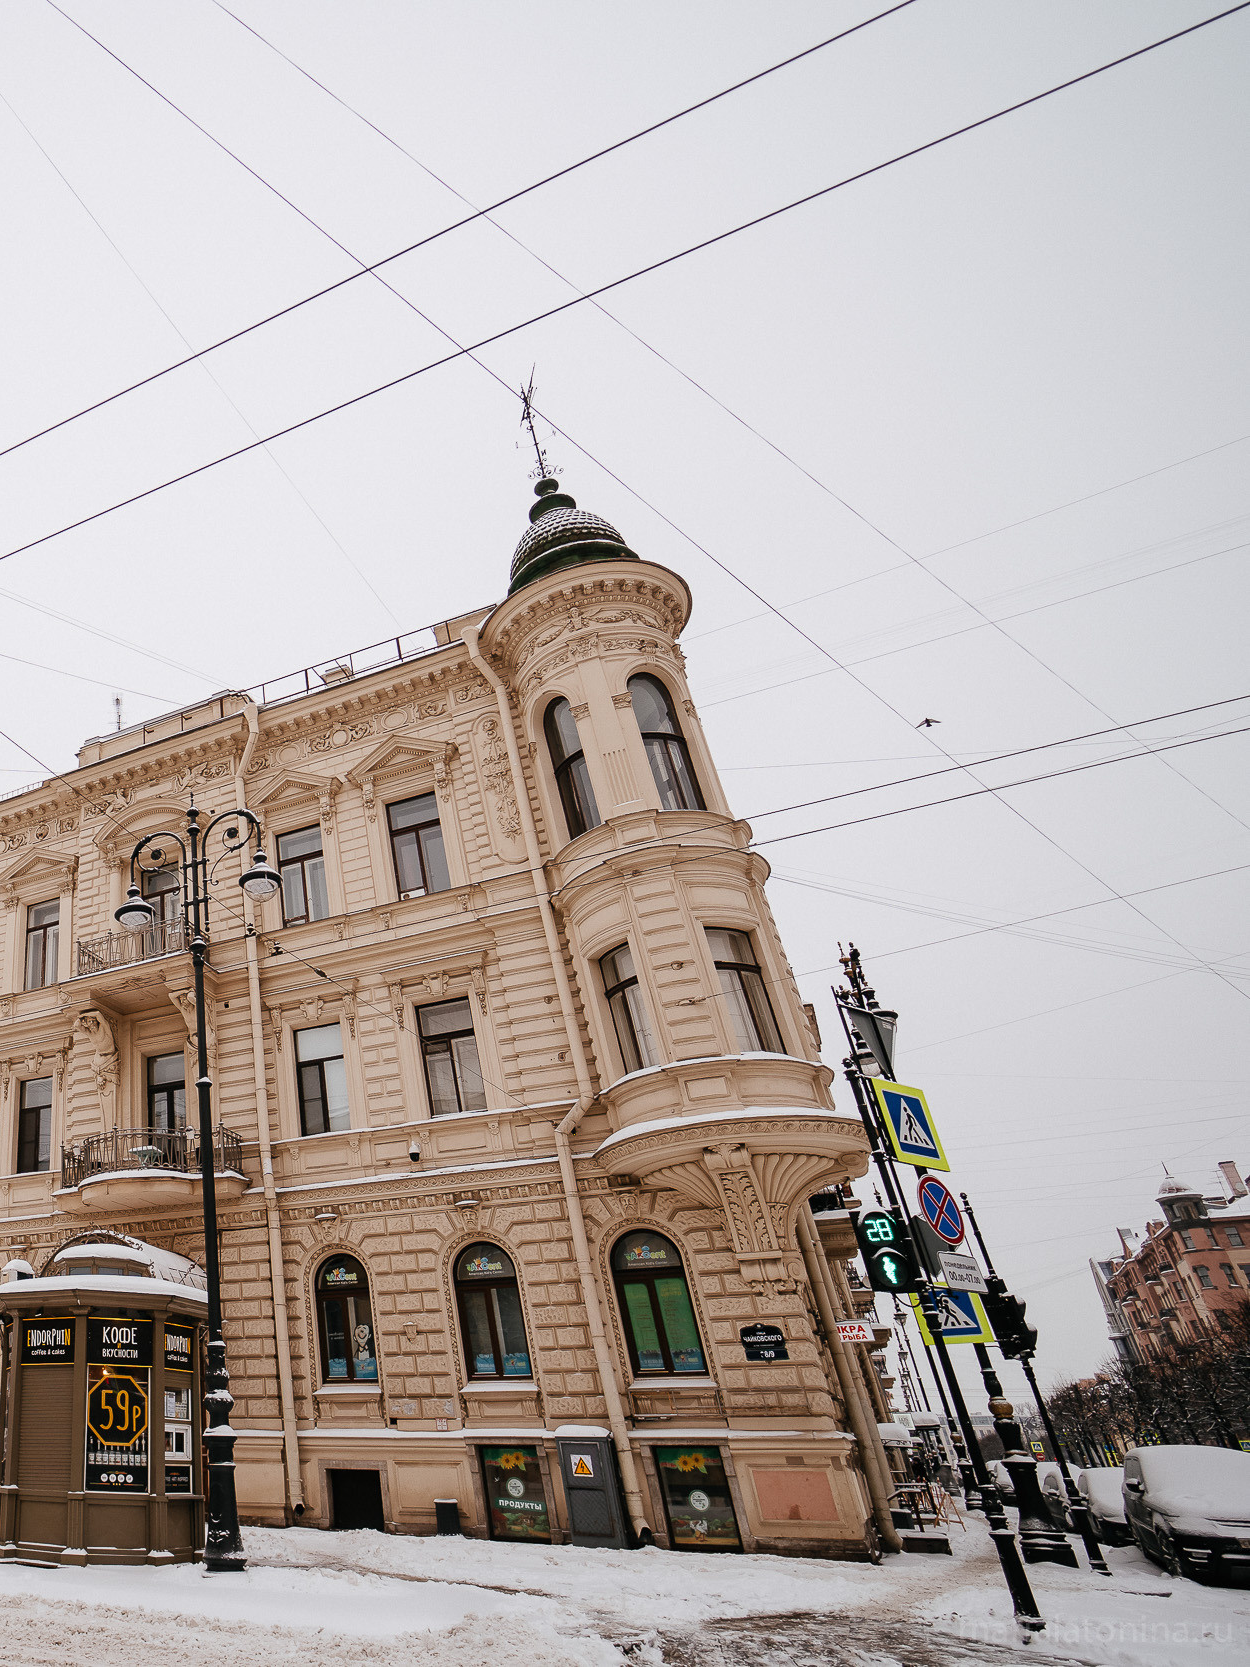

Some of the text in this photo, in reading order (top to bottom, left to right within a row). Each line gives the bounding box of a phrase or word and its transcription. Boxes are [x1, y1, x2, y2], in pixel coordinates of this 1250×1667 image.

[864, 1219, 894, 1242] 28
[27, 1328, 70, 1347] ENDORPHIN
[102, 1326, 138, 1345] КОФЕ
[164, 1333, 190, 1354] ENDORPHIN
[743, 1334, 783, 1342] ЧАЙКОВСКОГО
[102, 1348, 138, 1359] ВКУСНОСТИ
[498, 1499, 542, 1510] ПРОДУКТЫ
